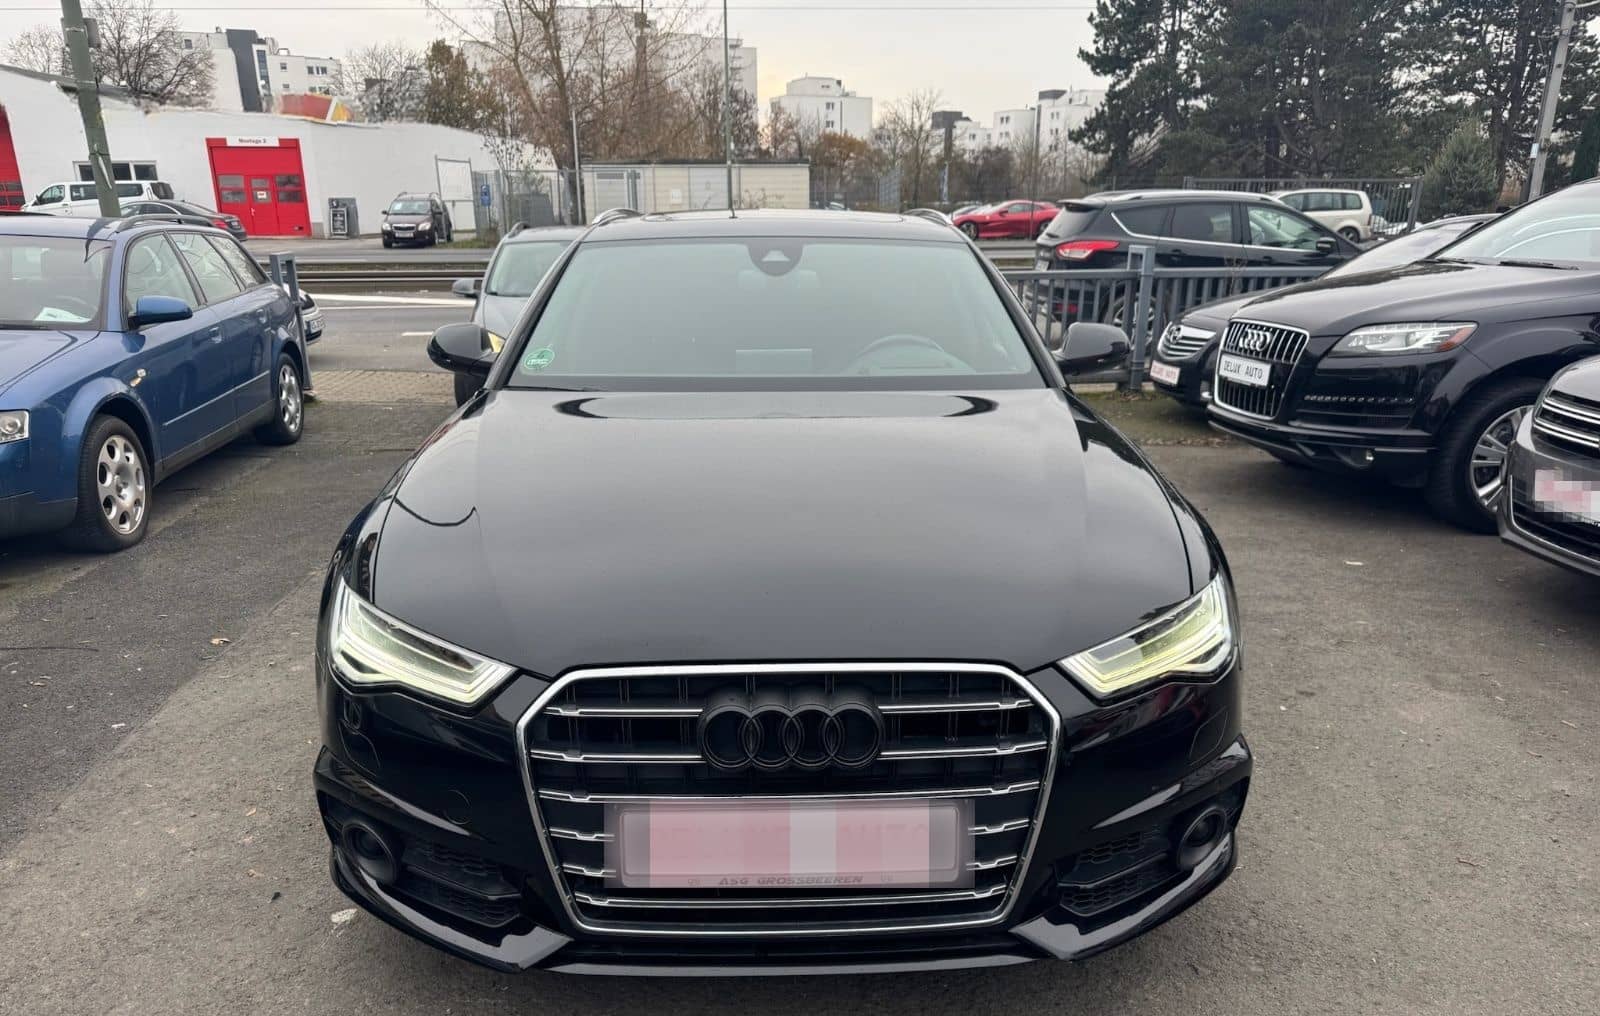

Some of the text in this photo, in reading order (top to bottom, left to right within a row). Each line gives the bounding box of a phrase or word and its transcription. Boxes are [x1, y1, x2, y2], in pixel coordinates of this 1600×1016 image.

[1245, 364, 1264, 380] AUTO
[719, 875, 864, 886] ASG GROSSBEEREN
